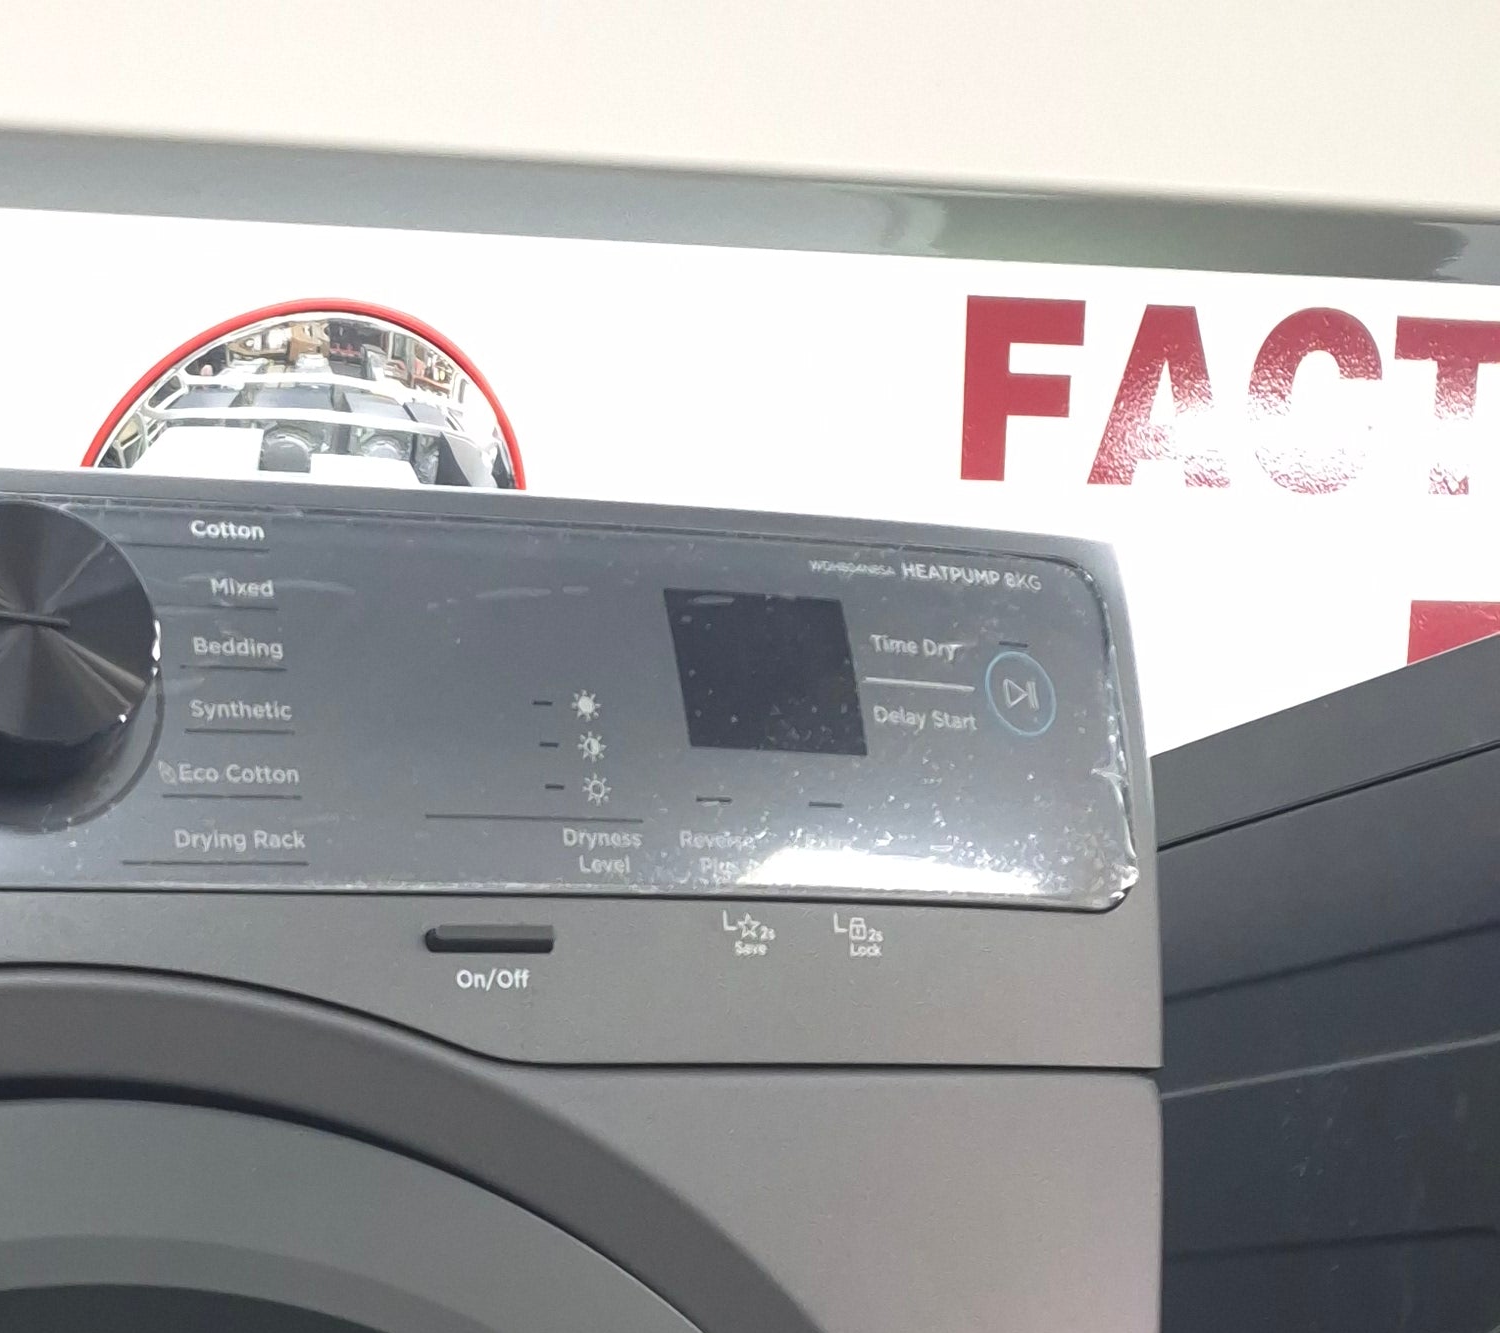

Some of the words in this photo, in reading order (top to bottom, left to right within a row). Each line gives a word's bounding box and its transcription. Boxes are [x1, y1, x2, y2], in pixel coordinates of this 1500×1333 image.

[190, 520, 266, 540] Cotton
[210, 577, 275, 598] Mixed
[901, 561, 1000, 586] HEATPUMP
[1003, 572, 1043, 591] 8KG
[193, 635, 284, 660] Bedding
[870, 634, 918, 655] Time
[922, 638, 962, 663] Dry
[189, 699, 293, 721] Synthetic
[873, 704, 926, 733] Delay
[931, 710, 978, 731] Start
[178, 762, 219, 783] Eco
[225, 763, 300, 785] Cotton
[174, 828, 248, 853] Drying
[253, 829, 307, 850] Rack
[562, 828, 643, 851] Dryness
[579, 855, 632, 875] Level
[850, 941, 883, 958] Lock
[456, 966, 530, 992] On/Off
